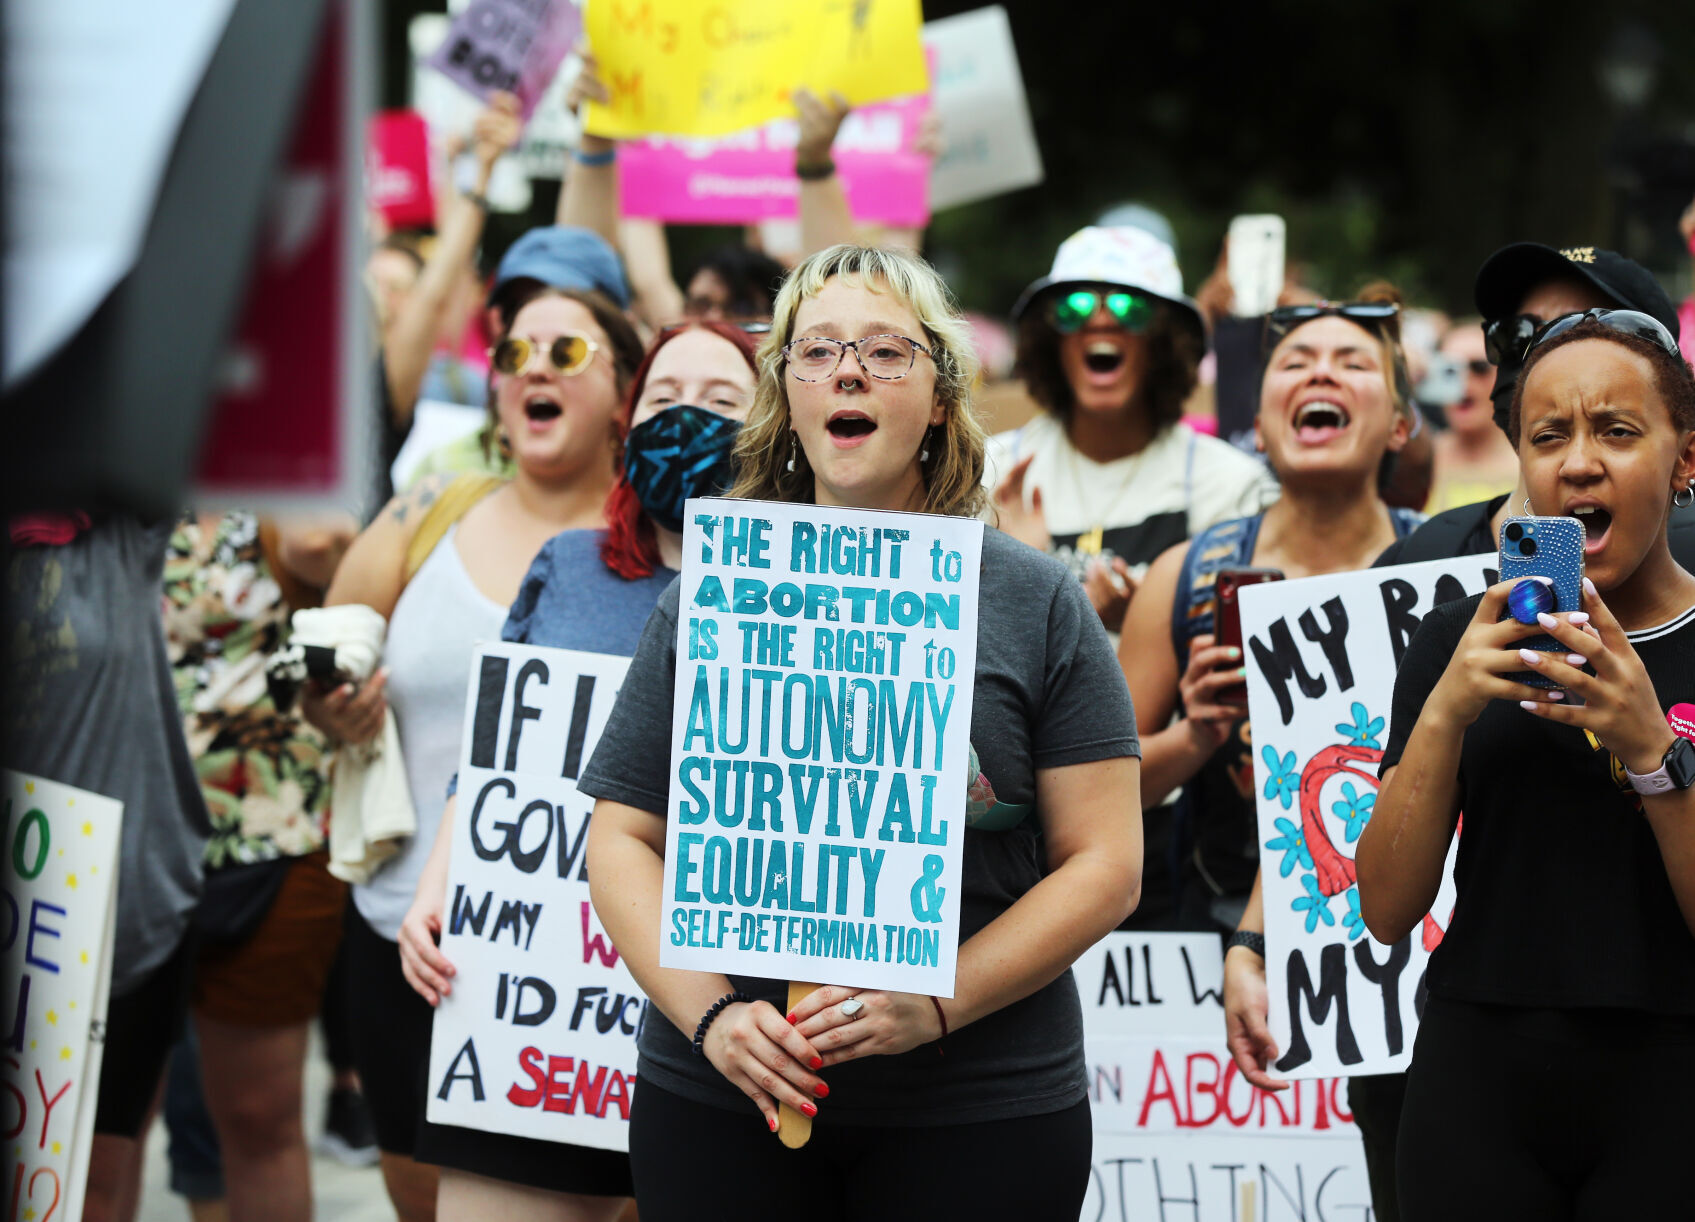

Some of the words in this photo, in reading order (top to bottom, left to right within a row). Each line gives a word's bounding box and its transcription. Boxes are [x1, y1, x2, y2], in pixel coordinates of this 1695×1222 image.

[694, 513, 773, 569] THE
[789, 520, 910, 579] RIGHT
[929, 538, 962, 583] to
[689, 575, 960, 631] ABORTION
[688, 617, 718, 661] IS
[737, 620, 797, 668] THE
[813, 627, 906, 676] RIGHT
[923, 637, 956, 680] to
[1248, 595, 1355, 726] MY
[561, 673, 597, 781] I
[682, 664, 955, 772] AUTONOMY
[470, 777, 592, 882] GOV
[678, 755, 948, 847] SURVIVAL
[673, 831, 886, 919] EQUALITY
[909, 852, 946, 924] &
[489, 899, 543, 953] MY
[669, 906, 939, 968] SELF-DETERMINATION
[495, 972, 557, 1027] I'D
[1097, 943, 1163, 1006] ALL
[1275, 936, 1412, 1073] MY
[436, 1036, 486, 1102] A
[506, 1045, 636, 1121] SENA
[1088, 1063, 1122, 1104] N
